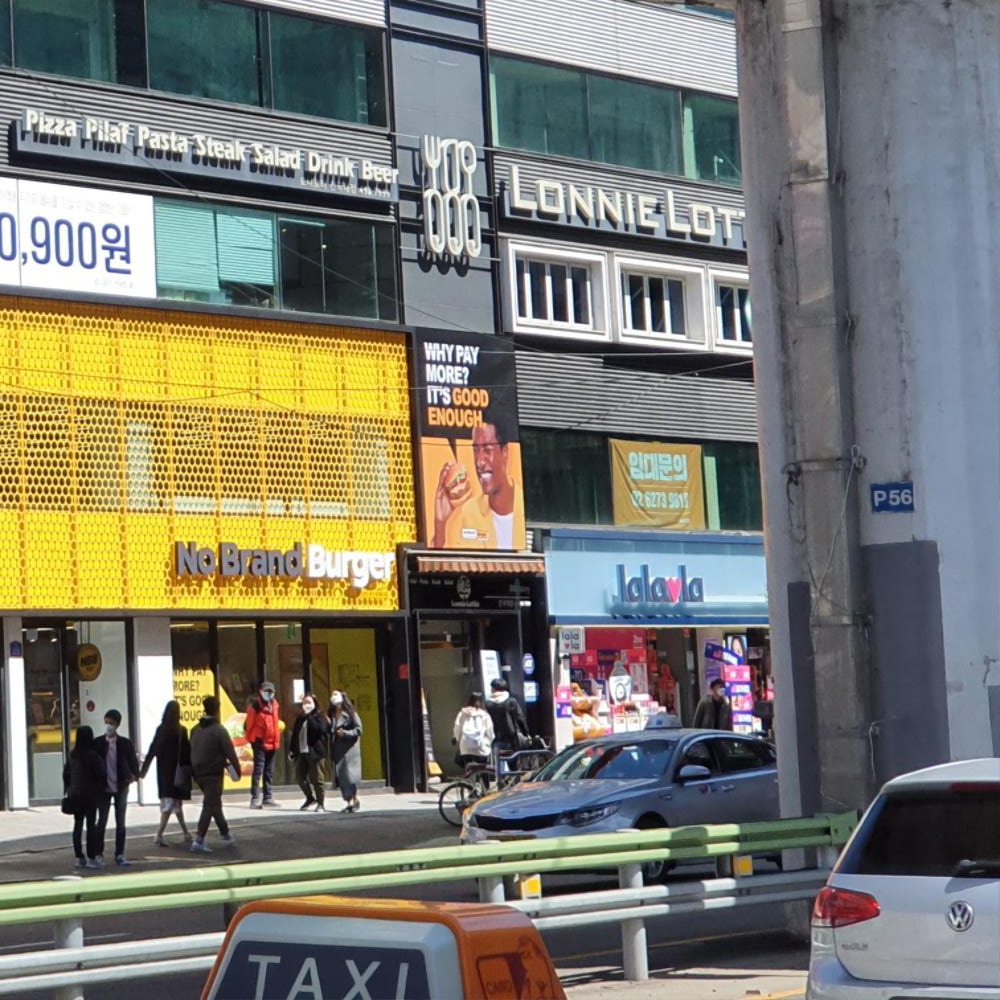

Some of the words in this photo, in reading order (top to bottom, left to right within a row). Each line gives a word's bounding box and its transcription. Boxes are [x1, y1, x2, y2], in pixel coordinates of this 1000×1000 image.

[25, 109, 77, 137] Pizza
[85, 116, 129, 144] Pilaf
[137, 126, 188, 153] Pasta
[193, 134, 246, 161] Steak
[251, 143, 301, 170] Salad
[308, 151, 355, 177] Drink
[361, 159, 399, 184] Beer
[509, 166, 659, 229] LONNIE
[664, 190, 746, 239] LOT
[424, 342, 454, 362] WHY
[456, 345, 479, 364] PAY
[425, 363, 469, 385] MORE?
[427, 385, 451, 405] IT'S
[452, 388, 489, 407] GOOD
[628, 451, 688, 481] 임대문의
[176, 541, 215, 575] No
[219, 541, 302, 577] Brand
[307, 543, 397, 588] Burger
[247, 953, 409, 1000] TAXI
